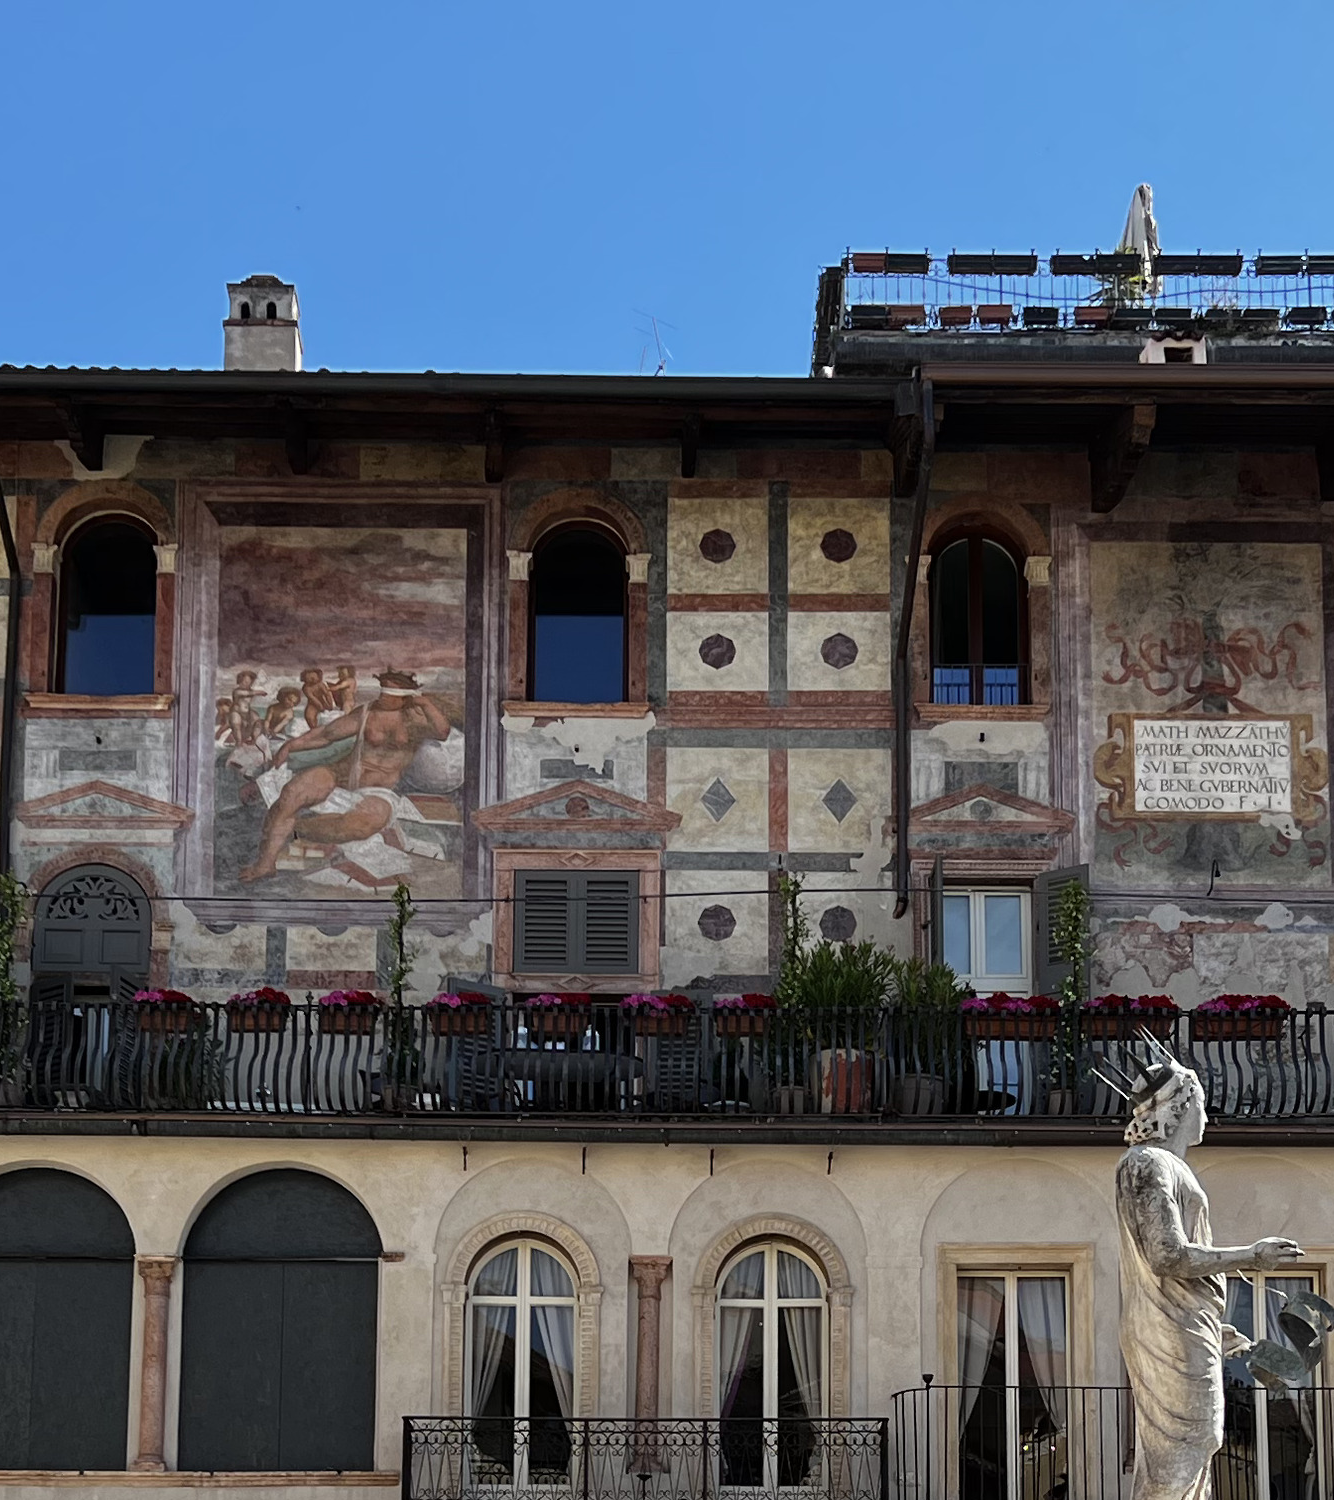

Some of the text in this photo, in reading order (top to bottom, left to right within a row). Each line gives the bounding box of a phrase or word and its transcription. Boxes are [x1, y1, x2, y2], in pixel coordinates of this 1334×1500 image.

[1141, 725, 1189, 739] MATH
[1191, 741, 1290, 758] ORNAMENTO
[1141, 760, 1270, 776] SVI ET SVORVM
[1135, 778, 1157, 793] AC
[1160, 779, 1196, 793] BENE
[1143, 796, 1225, 810] COMODO
